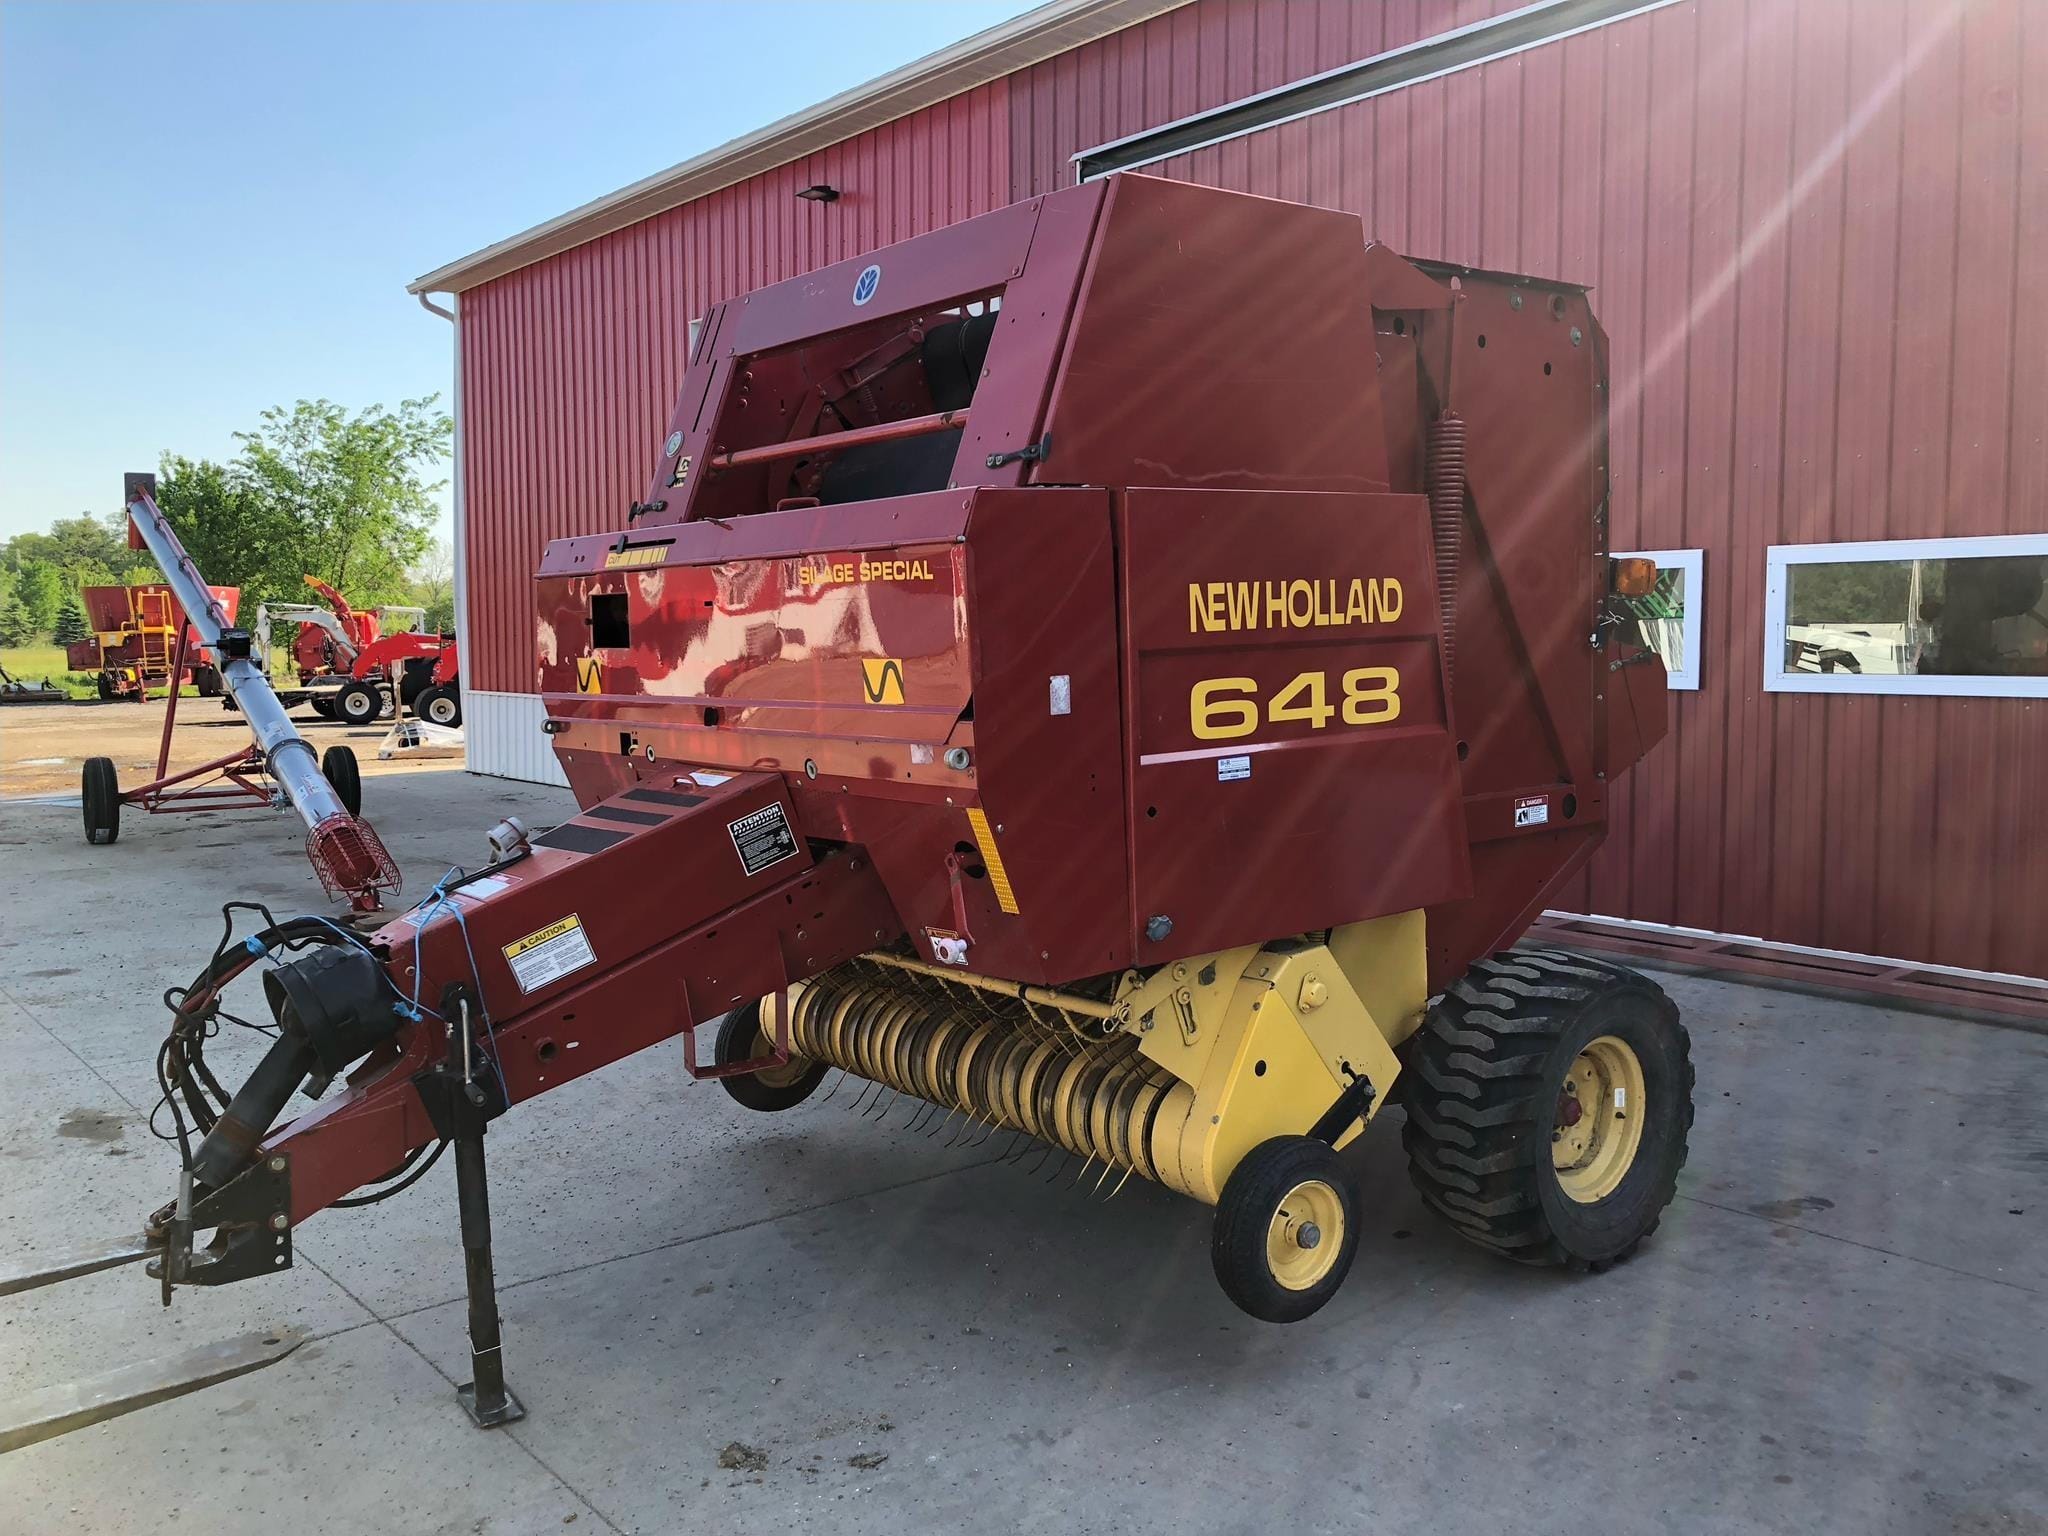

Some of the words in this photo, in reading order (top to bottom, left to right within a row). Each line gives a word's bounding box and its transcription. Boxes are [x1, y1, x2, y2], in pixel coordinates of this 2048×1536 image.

[800, 563, 854, 585] SILAGE
[859, 560, 934, 581] SPECIAL
[1189, 581, 1260, 633] NEW
[1265, 577, 1403, 629] HOLLAND
[1190, 666, 1401, 740] 648
[733, 805, 779, 832] ATTENTION
[528, 922, 567, 945] CAUTION
